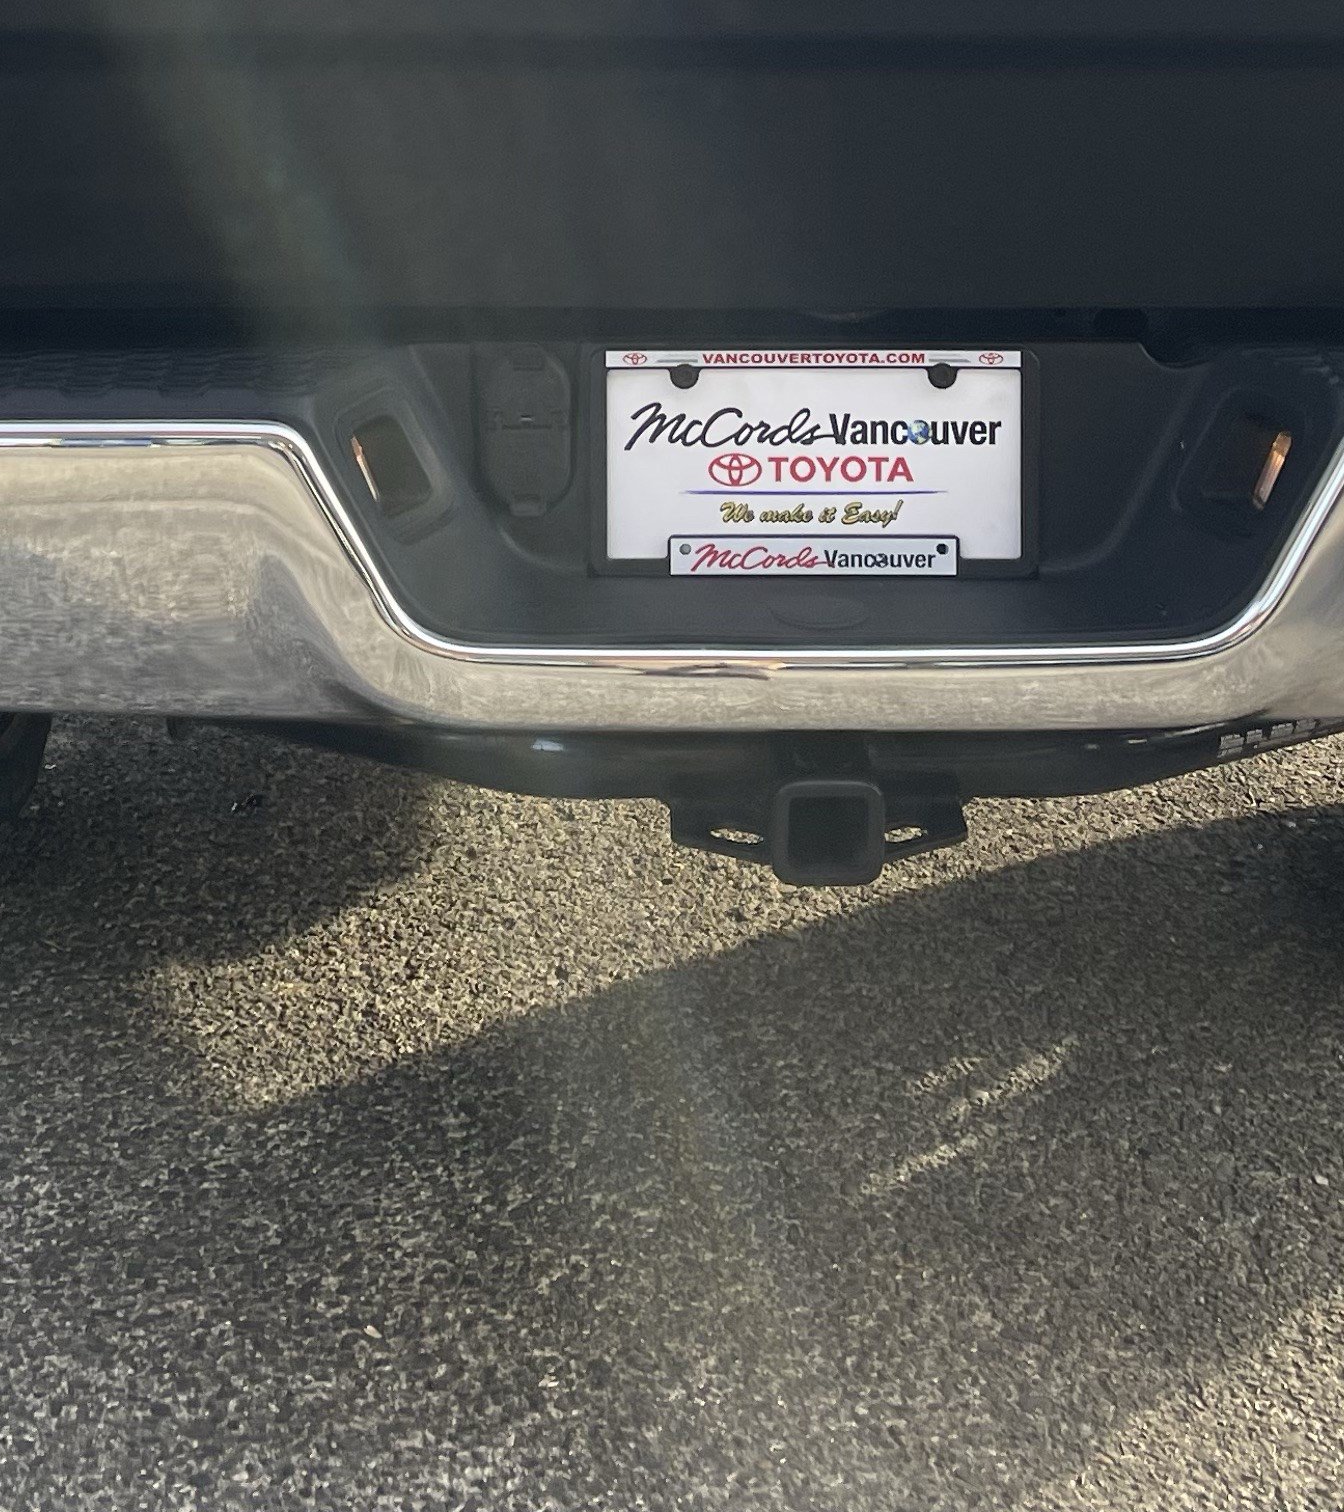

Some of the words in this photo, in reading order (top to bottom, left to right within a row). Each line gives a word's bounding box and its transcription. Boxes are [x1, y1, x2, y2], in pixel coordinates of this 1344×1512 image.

[702, 352, 926, 364] VANCOUVERTOYOTA.COM
[624, 401, 831, 451] McCords
[767, 456, 914, 483] TOYOTA
[720, 501, 755, 523] We
[759, 503, 814, 524] make
[818, 506, 838, 524] it
[841, 499, 904, 528] Easy!
[690, 543, 828, 571] McCords
